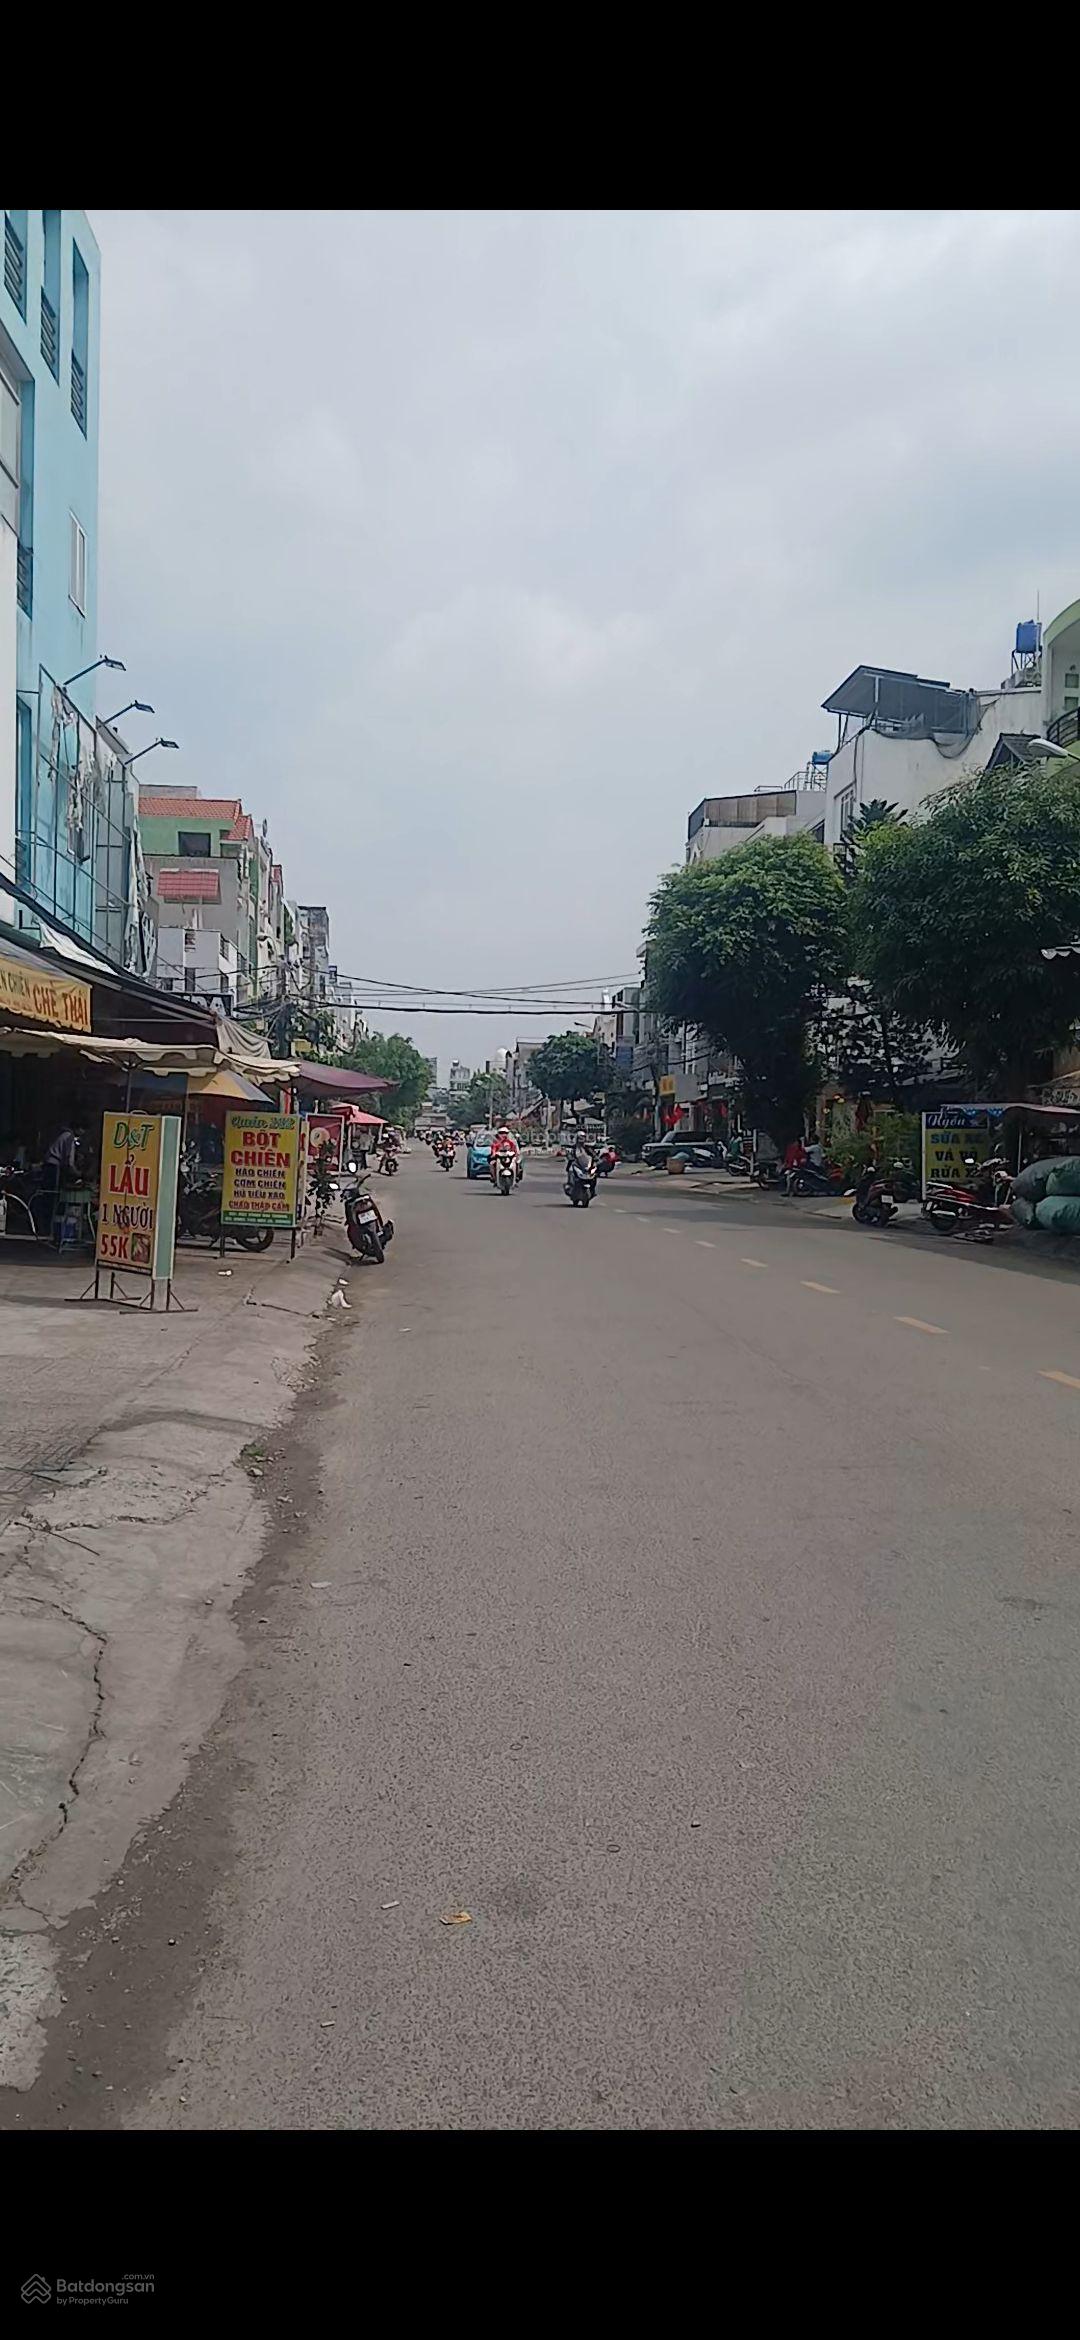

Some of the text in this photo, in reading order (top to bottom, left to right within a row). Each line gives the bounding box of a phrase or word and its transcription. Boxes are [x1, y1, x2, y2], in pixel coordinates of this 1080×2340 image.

[33, 980, 58, 1018] CHÈ
[62, 986, 88, 1025] THÁI
[113, 1121, 155, 1150] D&T
[243, 1129, 281, 1150] BỘT
[931, 1131, 960, 1144] SỬA
[231, 1149, 290, 1168] CHIÊN
[935, 1147, 954, 1161] VÁ
[109, 1154, 150, 1197] LẨU
[931, 1164, 960, 1178] RỬA
[102, 1202, 153, 1230] 1 NGƯỜI
[101, 1233, 130, 1260] 55K
